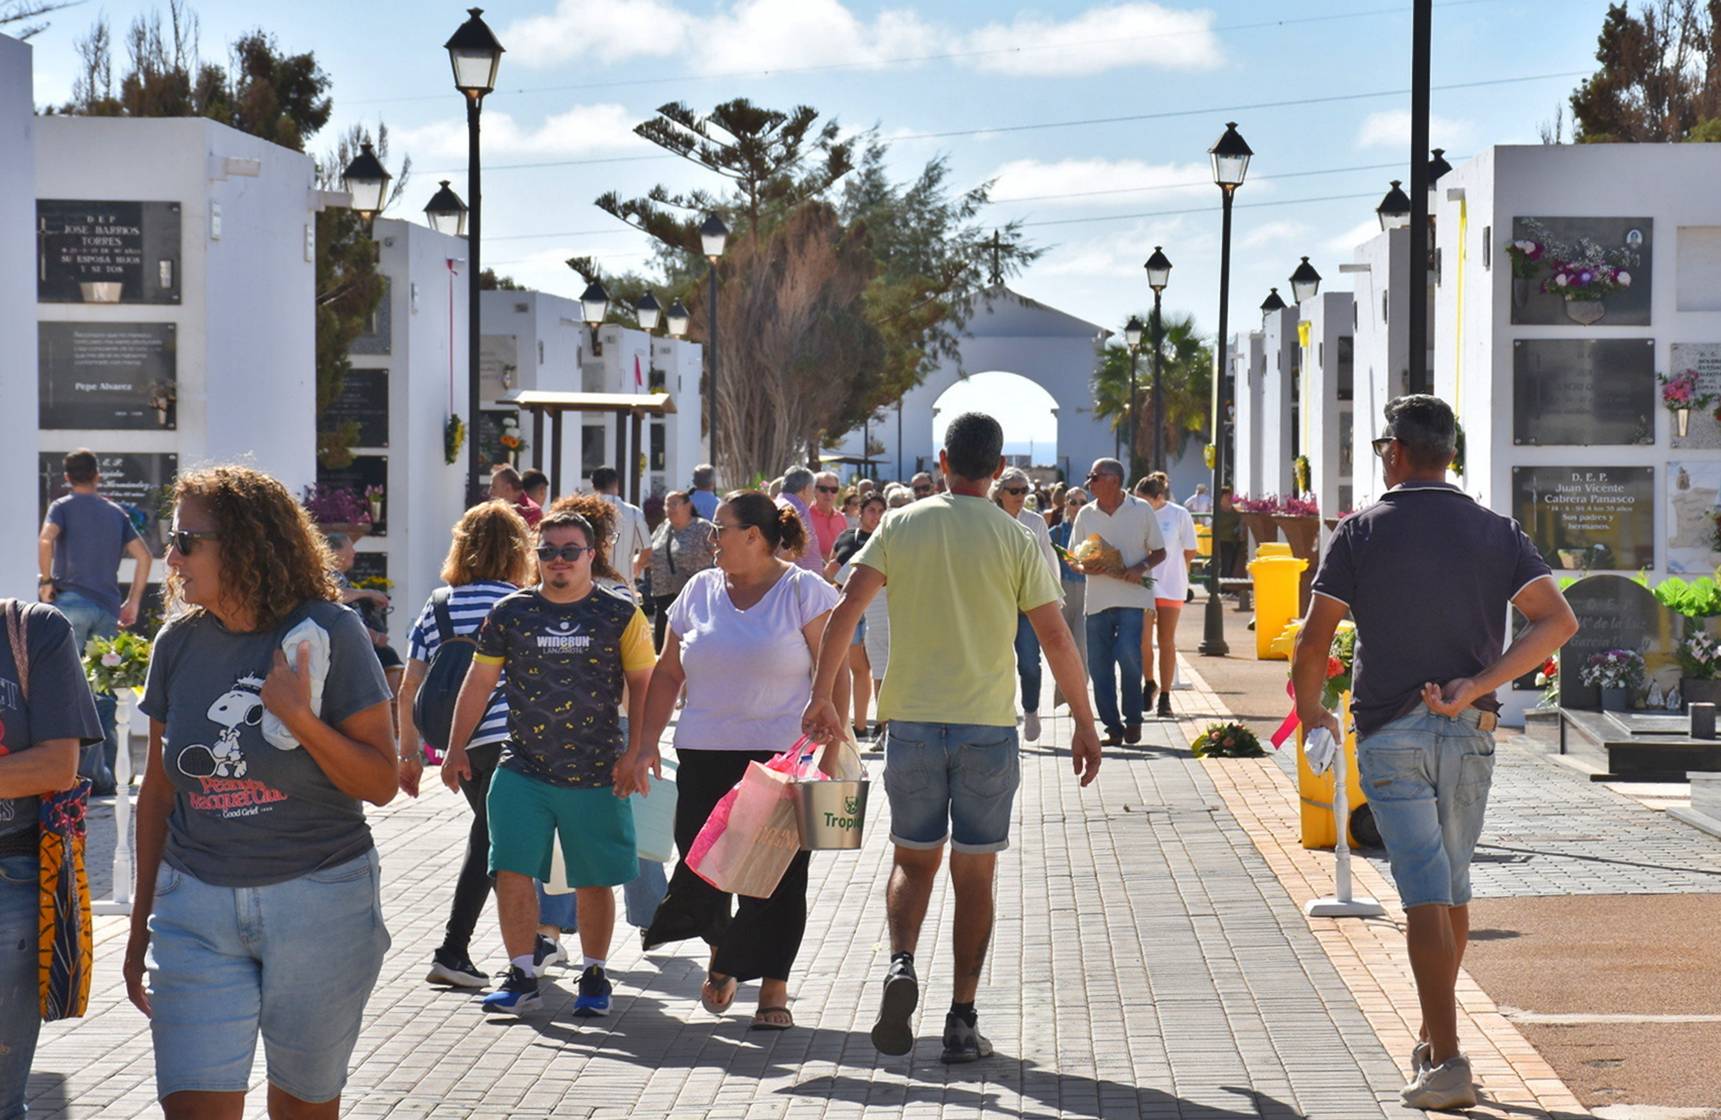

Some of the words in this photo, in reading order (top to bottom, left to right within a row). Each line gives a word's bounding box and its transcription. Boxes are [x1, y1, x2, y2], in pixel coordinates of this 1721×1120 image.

[81, 236, 123, 247] TORRES
[75, 382, 97, 392] Pepe
[1555, 484, 1582, 493] Juan
[1585, 483, 1625, 493] Vicente
[1544, 494, 1588, 504] Cabrera
[1591, 494, 1635, 504] Panasco
[223, 809, 241, 818] Good
[242, 806, 259, 816] Grief
